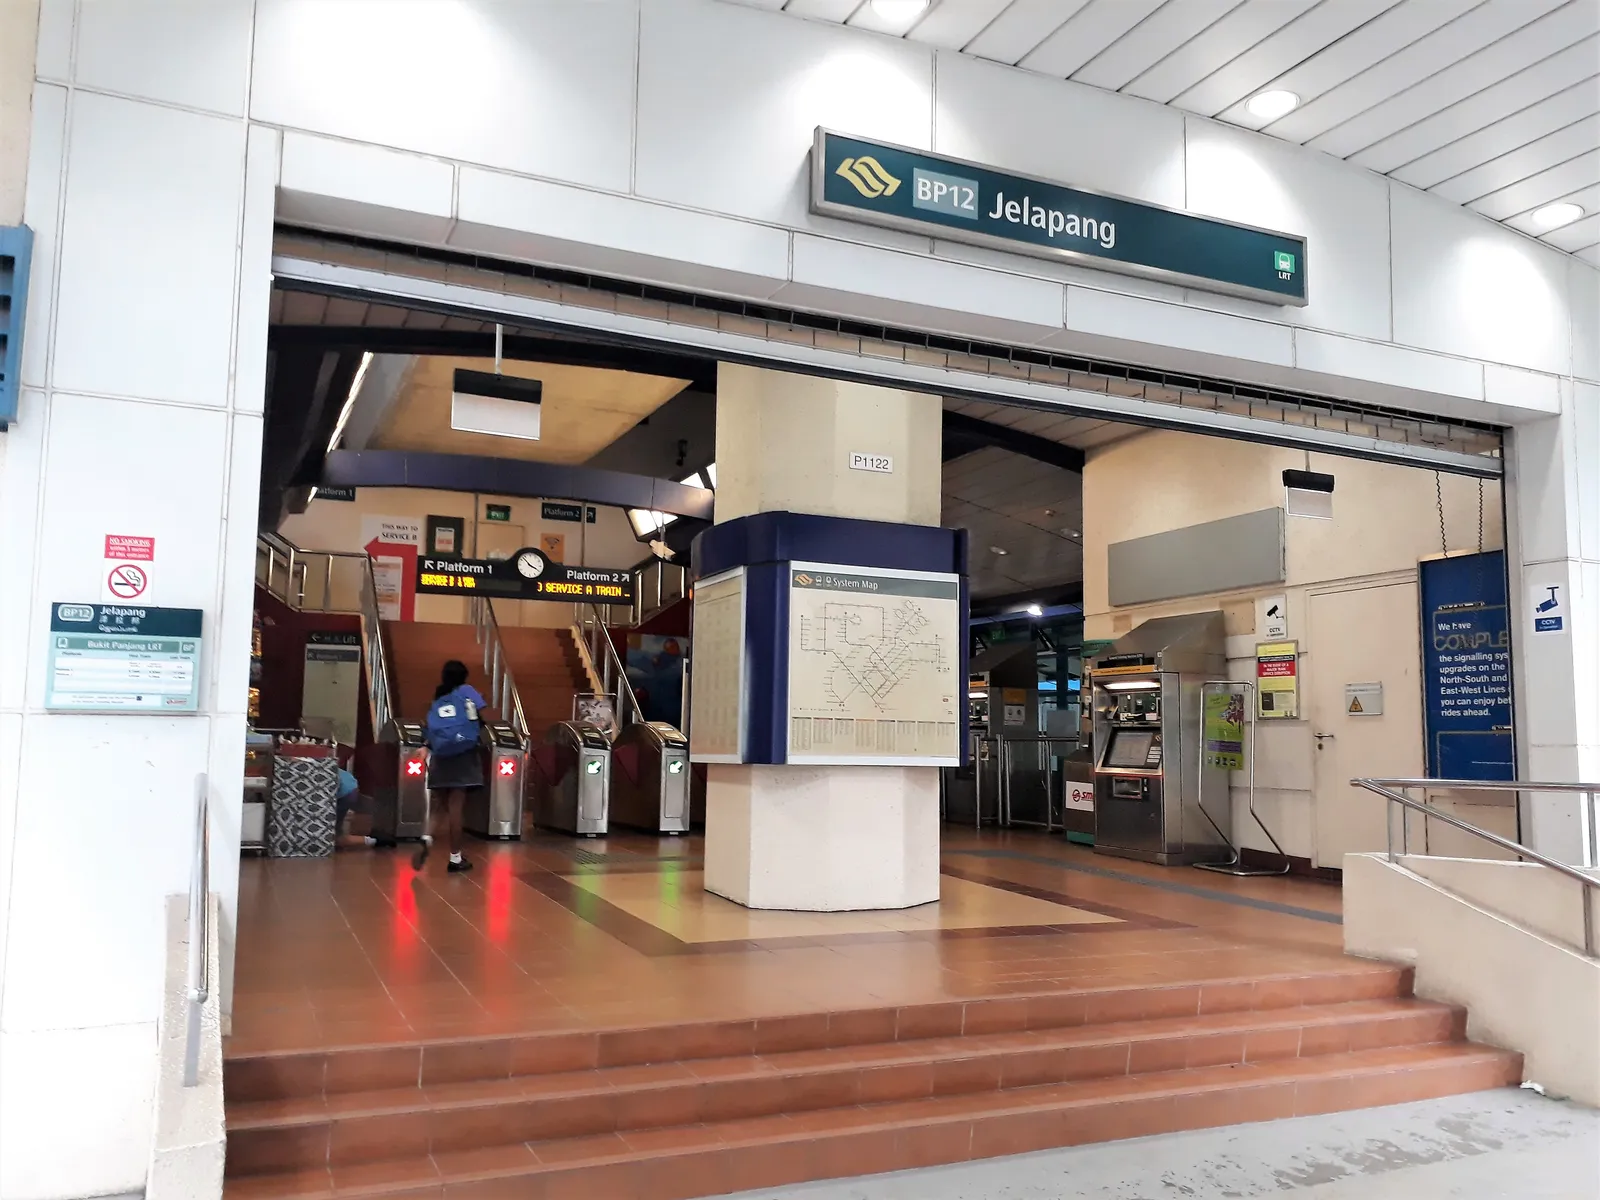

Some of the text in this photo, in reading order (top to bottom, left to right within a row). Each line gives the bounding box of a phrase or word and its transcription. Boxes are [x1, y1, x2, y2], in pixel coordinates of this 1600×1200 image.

[916, 177, 1116, 249] BP12 Jelapang
[1278, 271, 1292, 281] LRT
[854, 455, 889, 469] P1122
[544, 506, 580, 518] Platform 2
[436, 560, 493, 575] Platform 1
[566, 569, 619, 582] Platform 2
[545, 582, 583, 594] SERVICE
[585, 585, 593, 595] A
[595, 585, 622, 597] TRAIN
[833, 577, 879, 591] System Map
[63, 605, 146, 619] BP12 Jelapang
[1438, 623, 1451, 631] We
[87, 639, 163, 651] Bukit Panjang LRT
[1439, 655, 1453, 663] the
[1454, 652, 1493, 663] signalling
[1439, 663, 1506, 675] upgrades on the
[1440, 674, 1508, 684] North-South and
[1440, 686, 1482, 695] East-West
[1483, 685, 1506, 694] Lines
[1440, 699, 1455, 707] you
[1473, 697, 1496, 707] enjoy
[1441, 708, 1491, 717] rides ahead.
